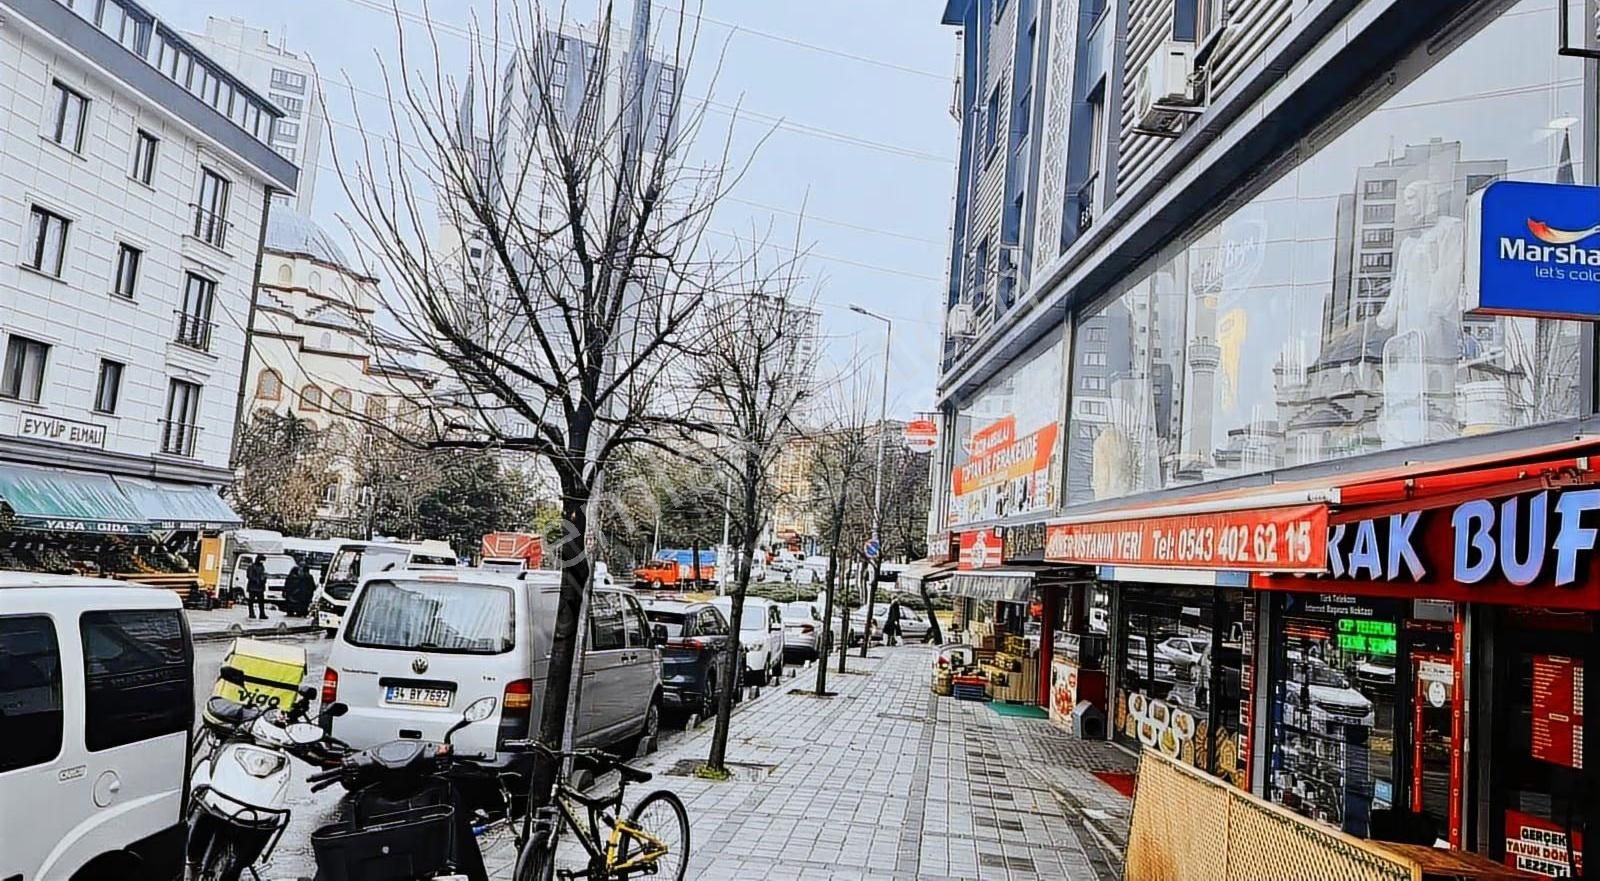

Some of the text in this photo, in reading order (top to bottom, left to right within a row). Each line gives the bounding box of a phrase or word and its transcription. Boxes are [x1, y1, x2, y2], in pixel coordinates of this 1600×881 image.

[1500, 237, 1600, 266] Marsha
[1535, 265, 1565, 279] let's
[70, 426, 102, 444] ELMALI
[97, 522, 129, 533] GIDA
[1117, 521, 1143, 560] YERİ
[1152, 528, 1175, 561] Tel:
[1178, 526, 1214, 561] 0543
[1217, 524, 1249, 562] 402
[1253, 522, 1279, 562] 62
[1285, 519, 1312, 563] 15
[1320, 510, 1427, 582] RAK
[1338, 618, 1354, 632] CEP
[394, 687, 405, 698] 34
[1521, 827, 1567, 847] GERÇEK
[1507, 840, 1540, 857] TAVUK
